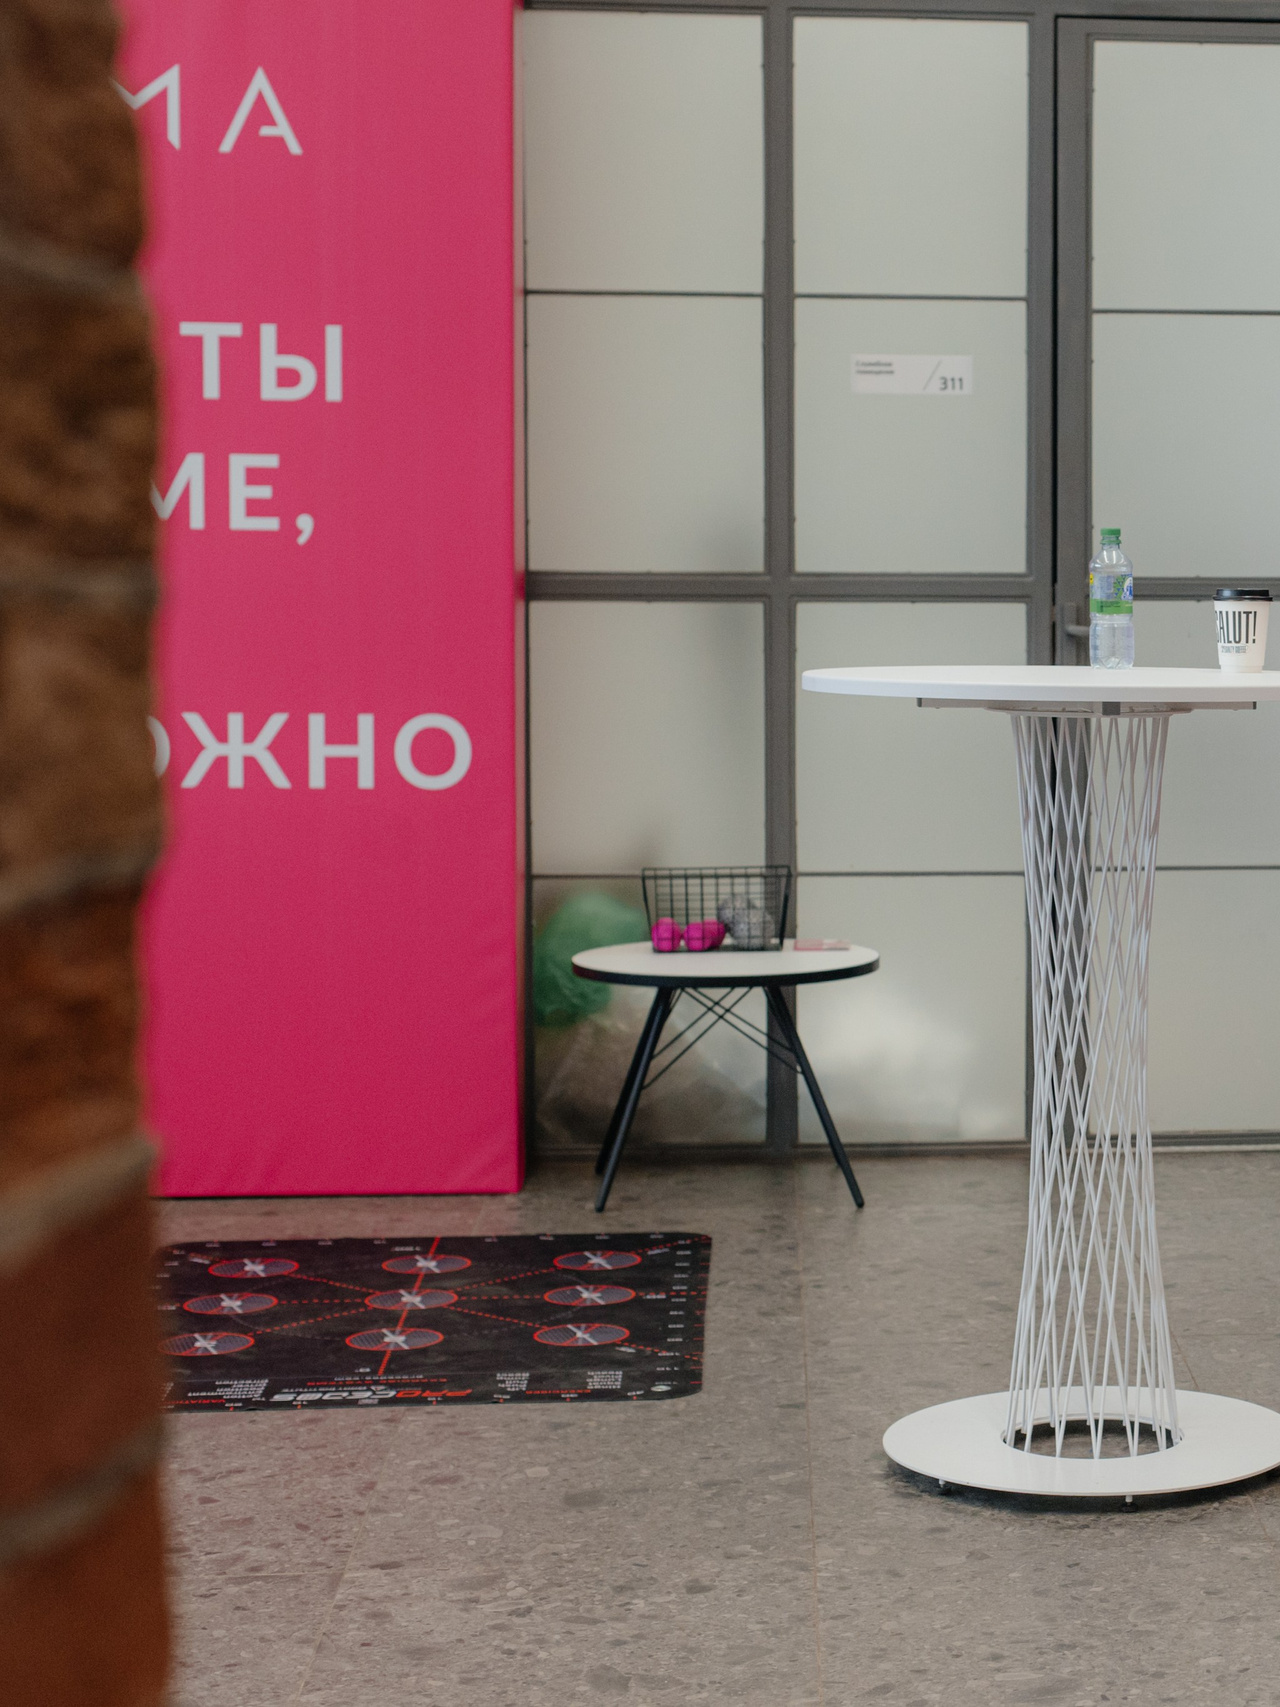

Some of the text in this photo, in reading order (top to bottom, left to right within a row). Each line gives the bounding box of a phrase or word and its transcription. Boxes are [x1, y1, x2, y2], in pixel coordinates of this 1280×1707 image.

[179, 322, 343, 402] ТЫ
[939, 376, 964, 391] 311
[1215, 610, 1258, 644] ALUT!
[149, 712, 473, 791] ЖНО
